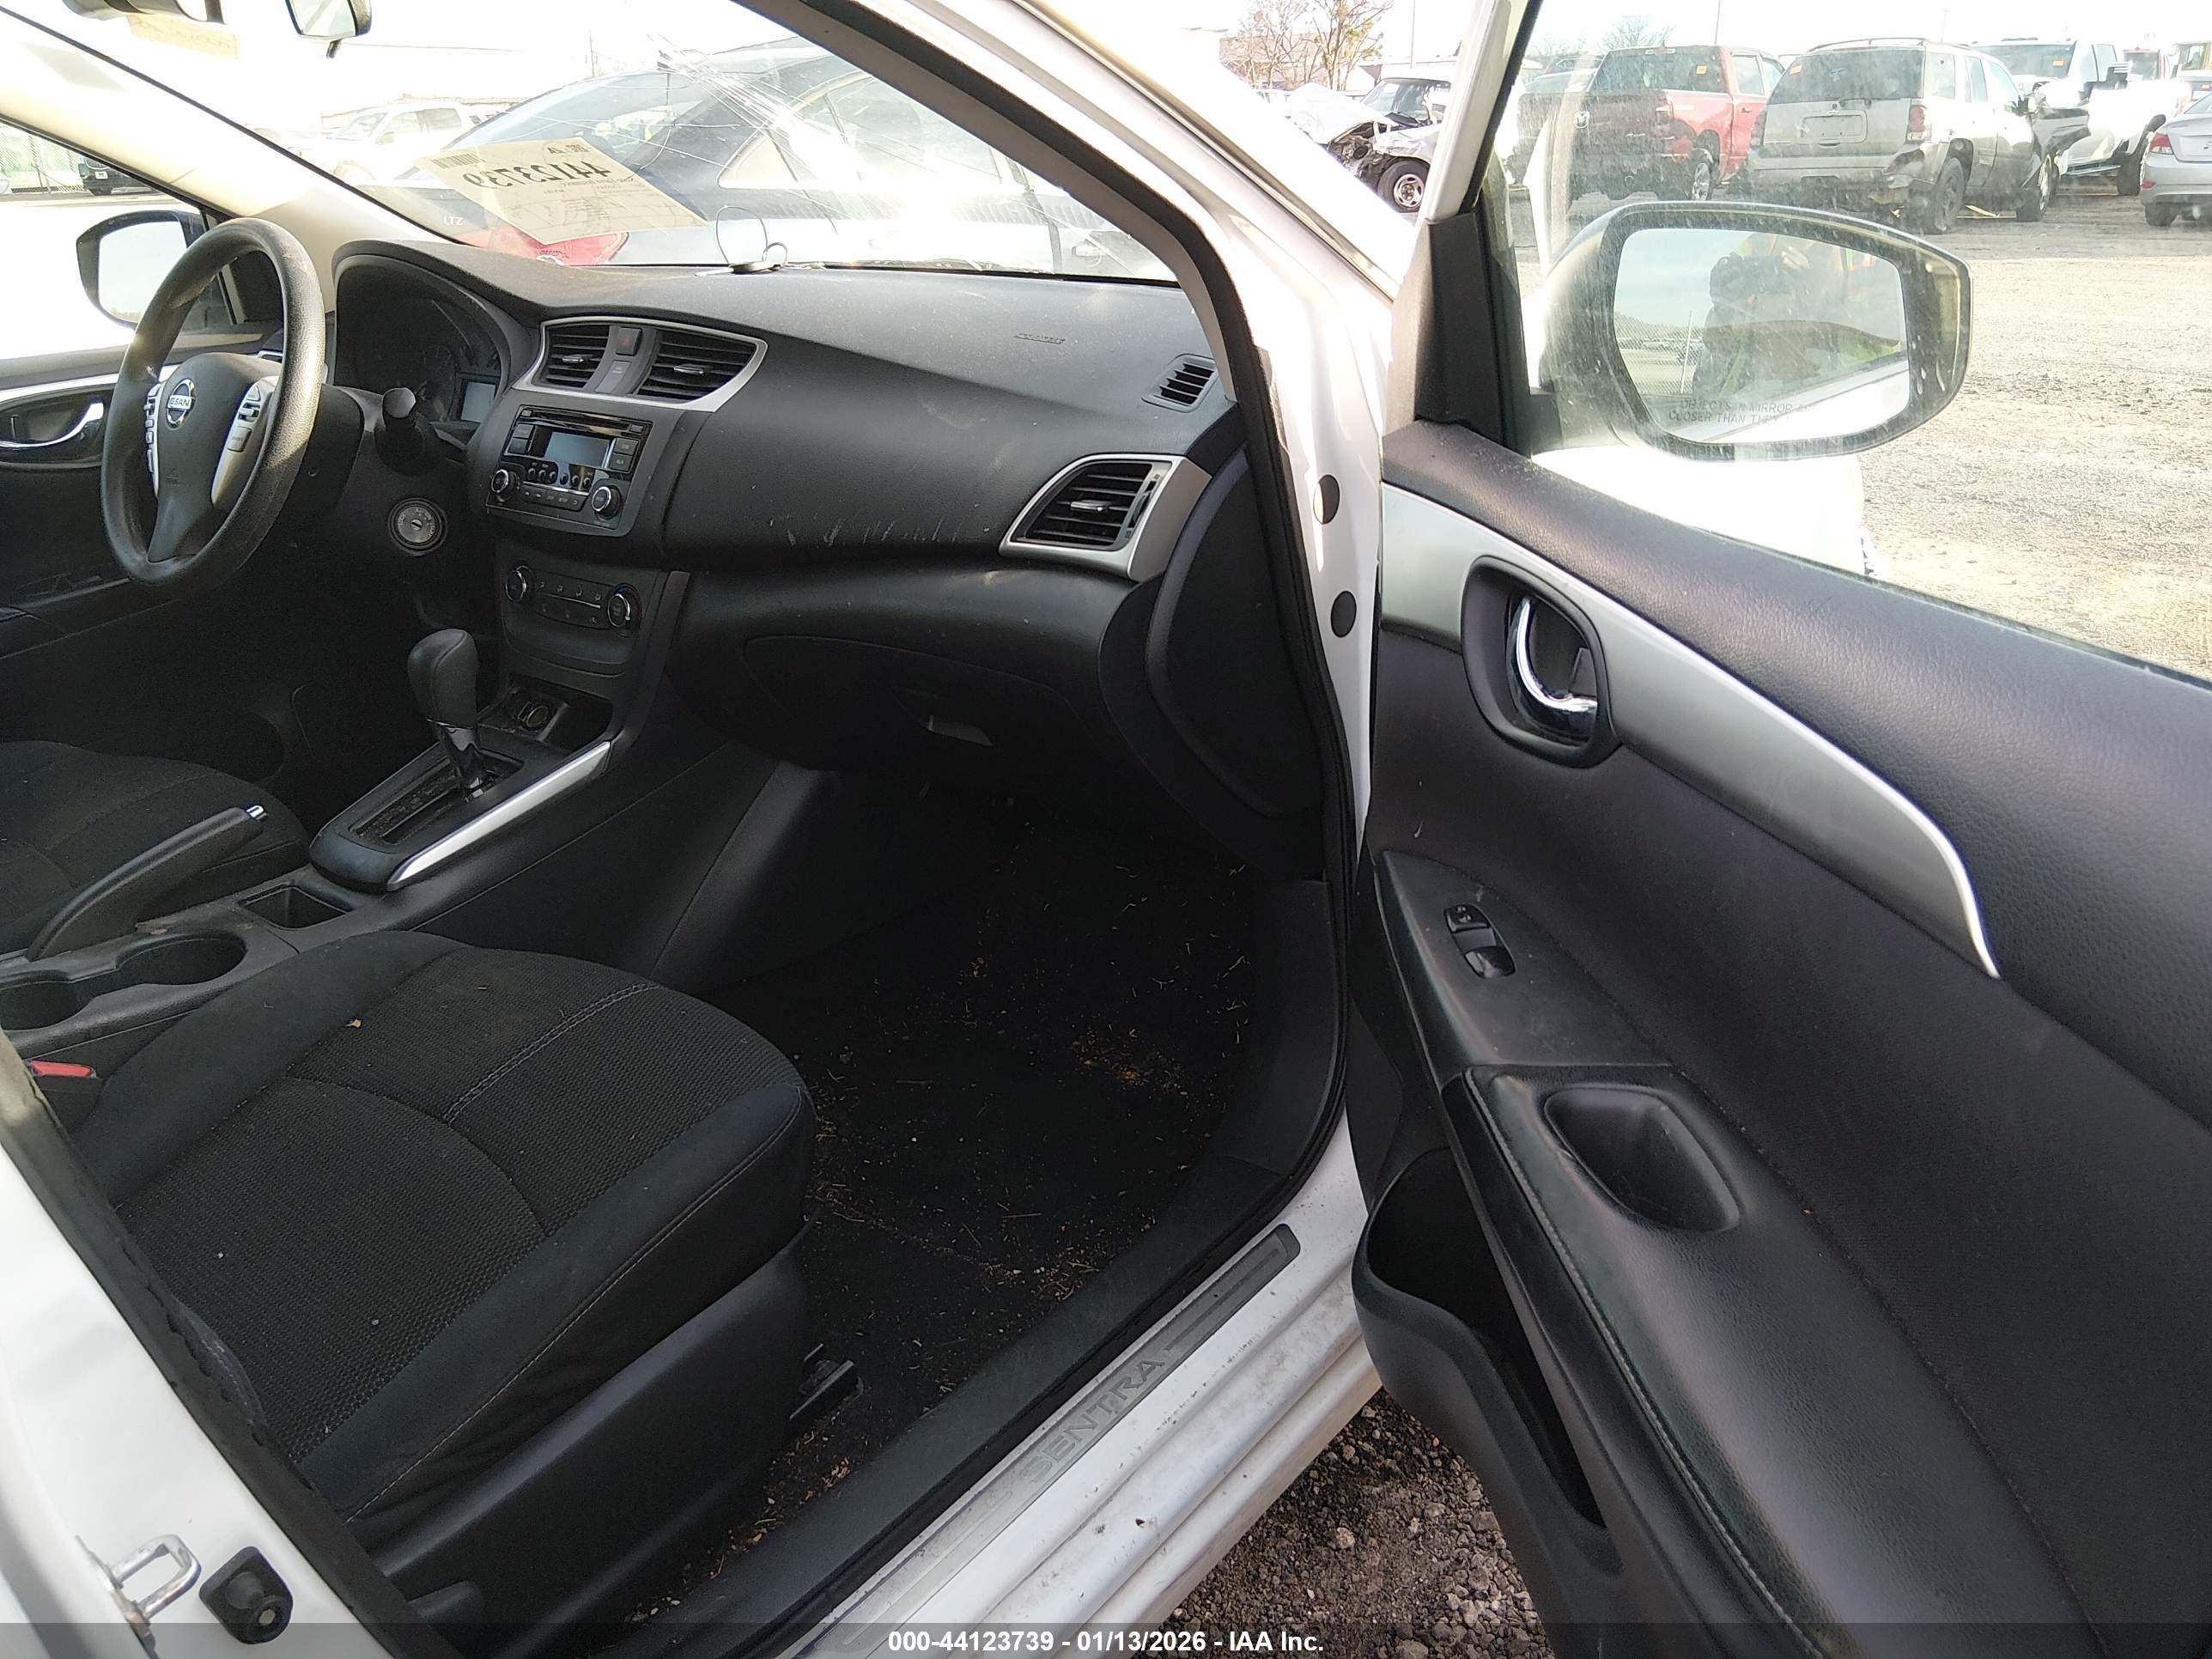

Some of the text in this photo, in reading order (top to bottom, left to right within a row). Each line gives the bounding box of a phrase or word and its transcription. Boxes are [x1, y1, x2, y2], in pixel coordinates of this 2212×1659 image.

[1681, 399, 1735, 413] OBJECTS
[1668, 410, 1711, 423] CLOSER
[1717, 413, 1747, 427] THAN
[1019, 1360, 1165, 1484] SENTRA
